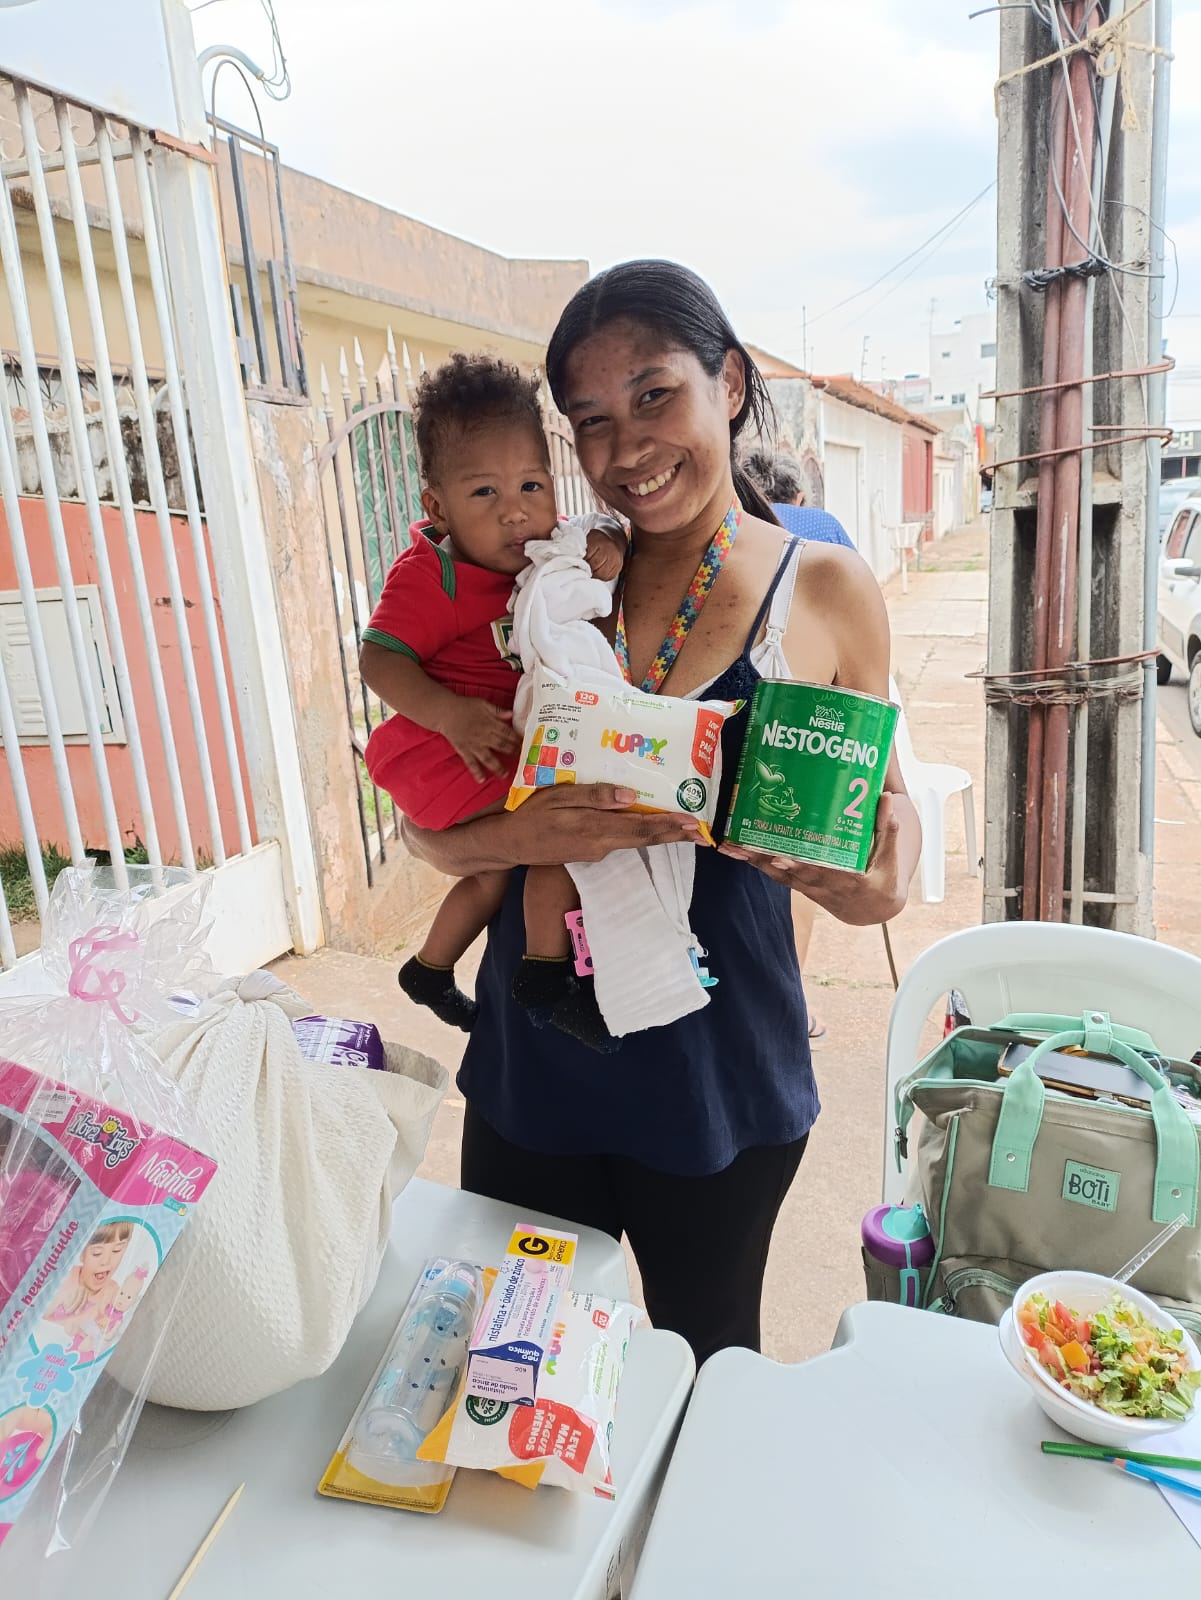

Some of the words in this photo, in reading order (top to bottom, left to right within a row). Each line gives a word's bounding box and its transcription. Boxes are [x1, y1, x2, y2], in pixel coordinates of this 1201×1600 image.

[600, 728, 668, 757] HUPPY
[761, 720, 879, 769] NESTOGENO
[843, 777, 870, 820] 2
[104, 1127, 137, 1169] Toys
[518, 1237, 550, 1255] G
[21, 1220, 80, 1307] peniquinho
[488, 1309, 508, 1342] nistatina
[502, 1284, 516, 1304] óxido
[510, 1276, 519, 1286] de
[515, 1258, 526, 1277] zinco
[508, 1345, 540, 1357] química
[472, 1378, 490, 1386] zinco
[477, 1385, 505, 1395] nistatina
[499, 1383, 518, 1393] óxido
[483, 1398, 496, 1415] 0%
[525, 1408, 545, 1451] MENOS
[537, 1412, 556, 1455] PAGUE
[553, 1423, 570, 1457] MAIS
[565, 1429, 582, 1460] LEVE
